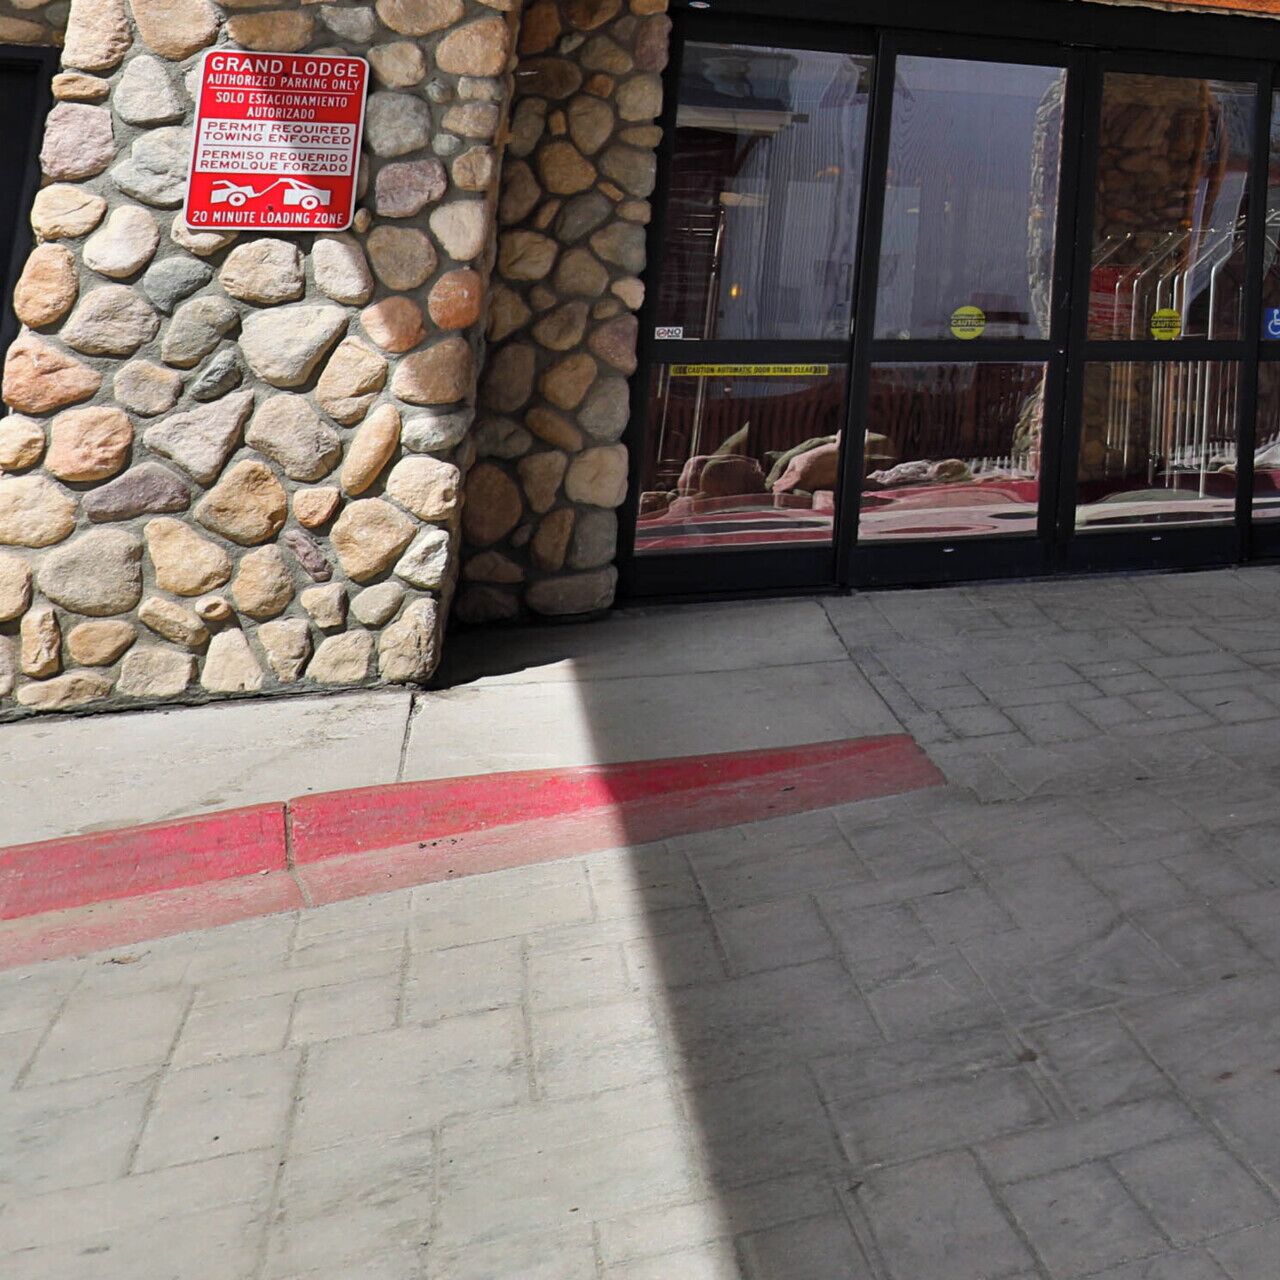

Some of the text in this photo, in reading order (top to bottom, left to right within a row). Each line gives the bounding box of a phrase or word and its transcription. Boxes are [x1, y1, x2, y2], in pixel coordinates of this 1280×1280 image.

[211, 56, 359, 78] GRAND LODGE
[207, 74, 360, 90] AUTHORIZED PARKING ONLY
[215, 92, 348, 108] SOLO ESTACIONAMIENTO
[246, 107, 315, 120] AUTORIZADO
[207, 122, 350, 135] PERMIT REQUIRED
[204, 131, 351, 145] TOWING ENFORCED
[202, 150, 348, 163] PERMISO REQUERIDO
[200, 160, 347, 172] REMOLQUE FORZADO
[192, 211, 343, 225] 20 MINUTE LOADING ZONE
